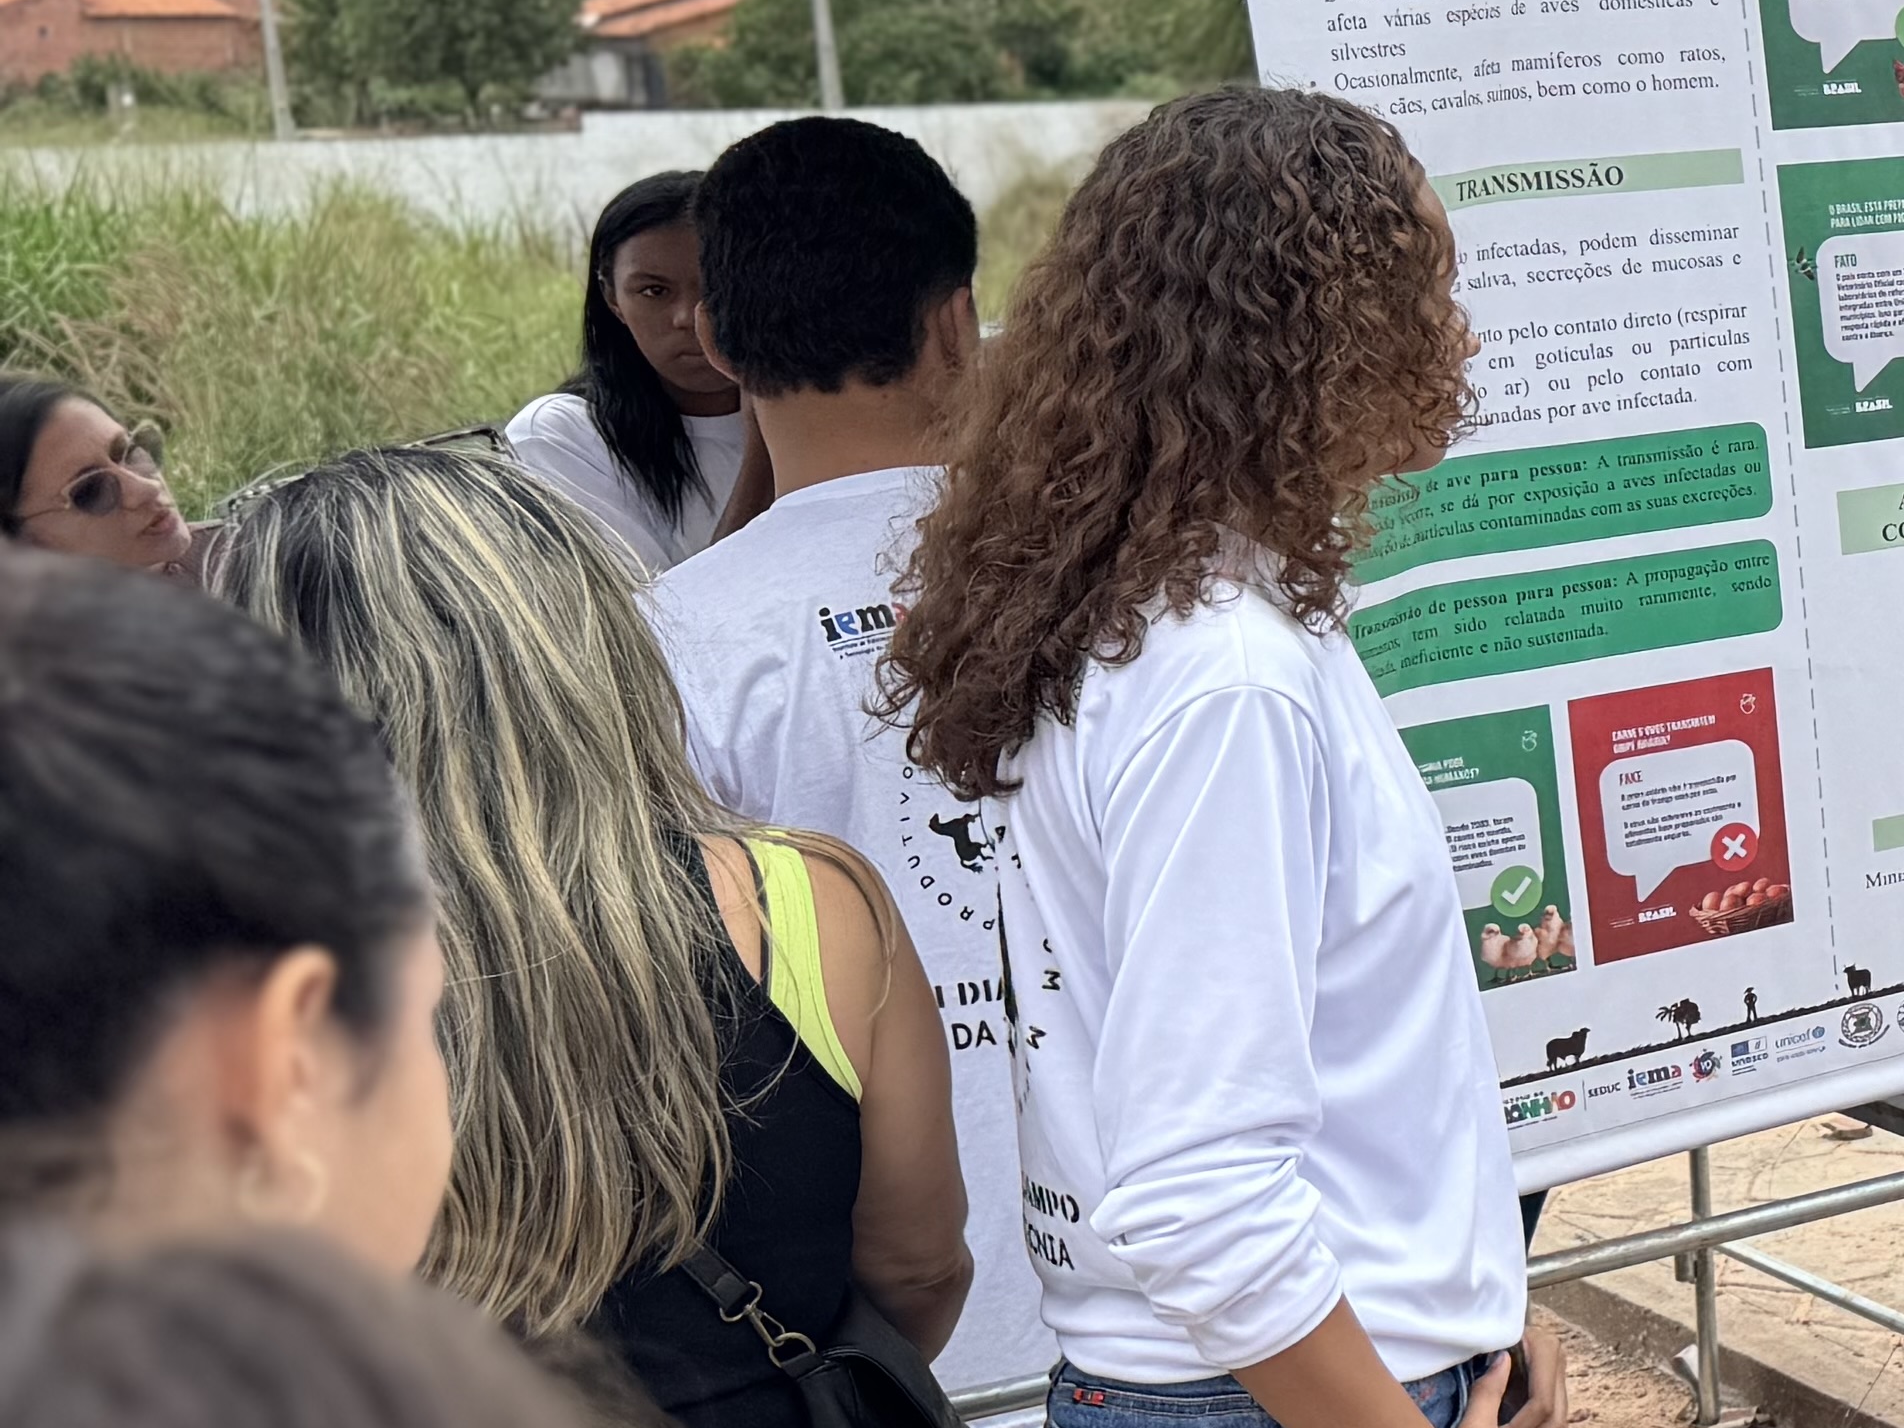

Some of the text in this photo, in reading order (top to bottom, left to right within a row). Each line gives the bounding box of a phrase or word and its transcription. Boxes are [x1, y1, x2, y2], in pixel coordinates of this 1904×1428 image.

[1327, 14, 1367, 32] afeta
[1383, 8, 1431, 28] várias
[1446, 2, 1500, 24] espécies
[1510, 0, 1526, 15] de
[1331, 41, 1406, 62] silvestres
[1334, 45, 1726, 91] Ocasionalmente, afeta mamíferos como ratos,
[1389, 96, 1427, 115] cães,
[1537, 79, 1576, 99] bem
[1582, 81, 1631, 96] como
[1652, 74, 1719, 92] homem.
[1456, 163, 1624, 202] TRANSMISSÃO
[1476, 241, 1567, 262] infectadas,
[1579, 233, 1638, 256] podem
[1649, 224, 1740, 246] disseminar
[1834, 254, 1856, 268] FATO
[1467, 256, 1723, 291] saliva, secreções de mucosas
[1509, 321, 1548, 345] pelo
[1554, 317, 1617, 336] contato
[1623, 312, 1672, 330] direto
[1677, 303, 1748, 328] (respirar
[1489, 355, 1514, 370] em
[1632, 342, 1652, 356] ou
[1505, 378, 1531, 398] ar)
[1548, 378, 1571, 392] ou
[1587, 370, 1624, 392] pelo
[1640, 362, 1701, 382] contato
[1717, 357, 1753, 373] com
[1548, 404, 1576, 424] por
[1582, 400, 1611, 415] ave
[1617, 389, 1697, 411] infectada.
[1447, 439, 1760, 489] ave para pessoa: A transmissão é rara.
[1440, 460, 1762, 513] se dá por exposição aves infectadas ou
[1479, 484, 1757, 532] contaminadas com suas excreções.
[1428, 554, 1770, 615] de pessoa para pessoa: A propagação entre
[1412, 623, 1438, 644] tem
[1454, 616, 1488, 637] sido
[1504, 606, 1566, 628] relatada
[1580, 597, 1624, 616] muito
[1731, 575, 1772, 593] sendo
[1399, 642, 1475, 671] ineficiente
[1494, 633, 1522, 652] não
[1527, 622, 1609, 647] sustentada.
[951, 1020, 997, 1050] DA
[1627, 1065, 1682, 1089] iema
[1023, 1174, 1080, 1223] AMPO
